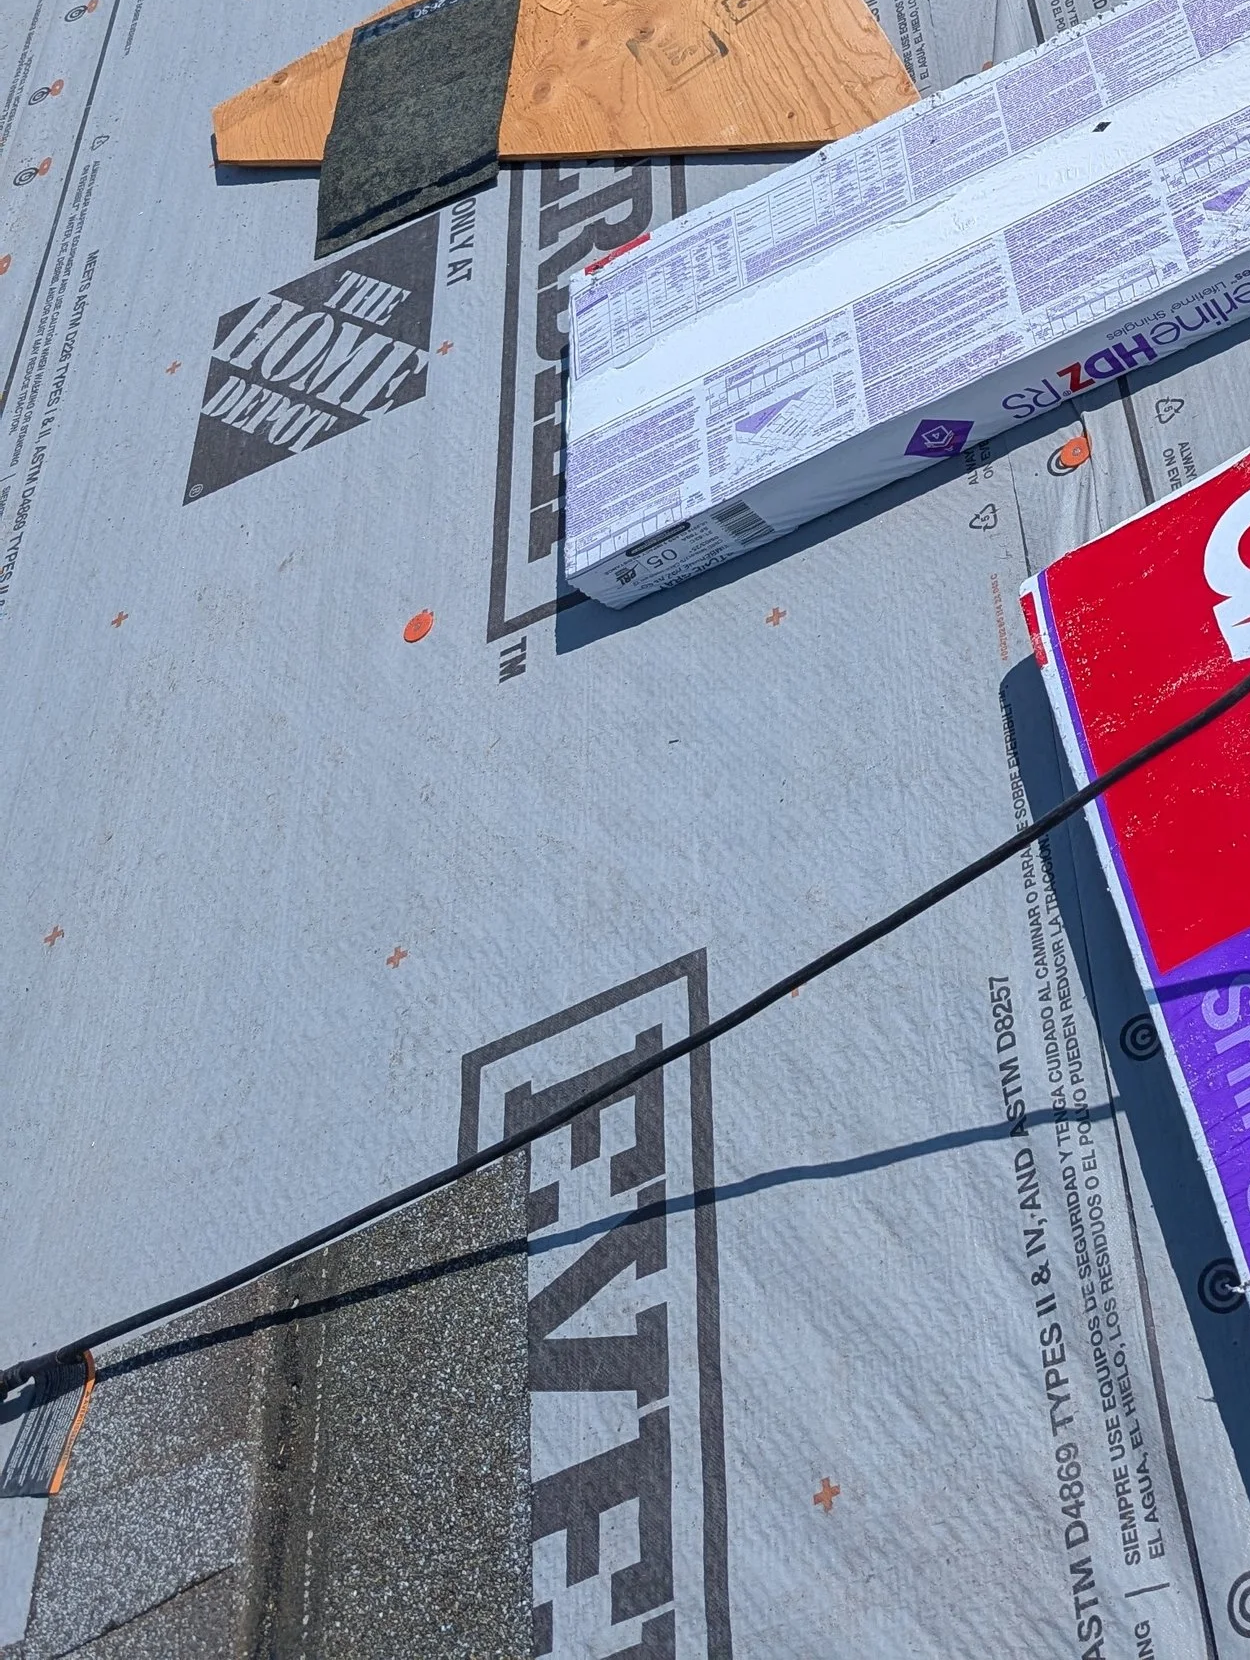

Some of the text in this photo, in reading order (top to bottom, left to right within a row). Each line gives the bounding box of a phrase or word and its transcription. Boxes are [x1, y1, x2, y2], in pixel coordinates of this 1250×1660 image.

[446, 196, 476, 286] ONLY AT
[78, 247, 99, 294] MEETS
[67, 292, 89, 331] ASTM
[323, 269, 411, 325] THE
[58, 327, 79, 364] D226
[1103, 305, 1168, 346] Shingles
[211, 293, 430, 420] HOME
[45, 360, 70, 409] TYPES
[999, 376, 1061, 425] RS
[200, 375, 338, 453] DEPOT
[24, 442, 47, 487] ASTM
[644, 545, 679, 571] 05
[500, 634, 527, 684] TM
[1048, 912, 1064, 934] LA
[1049, 940, 1074, 1011] REDUCIR
[1061, 1012, 1084, 1084] PUEDEN
[1071, 1087, 1093, 1145] POLVO
[1008, 769, 1142, 1566] SIEMPRE USE EQUIPOS DE SEGURIDAD TENGA CUIDADO AL CAMINAR SOBRE
[1080, 1149, 1097, 1171] EL
[1084, 1193, 1117, 1294] RESIDUOS
[985, 974, 1106, 1660] ASTM D4869 TYPES II & IV, AND ASTM D8257
[1101, 1295, 1123, 1340] LOS
[1110, 1342, 1139, 1416] HIELO,
[1126, 1418, 1144, 1446] EL
[1132, 1450, 1159, 1524] AGUA,
[1145, 1527, 1165, 1559] EL
